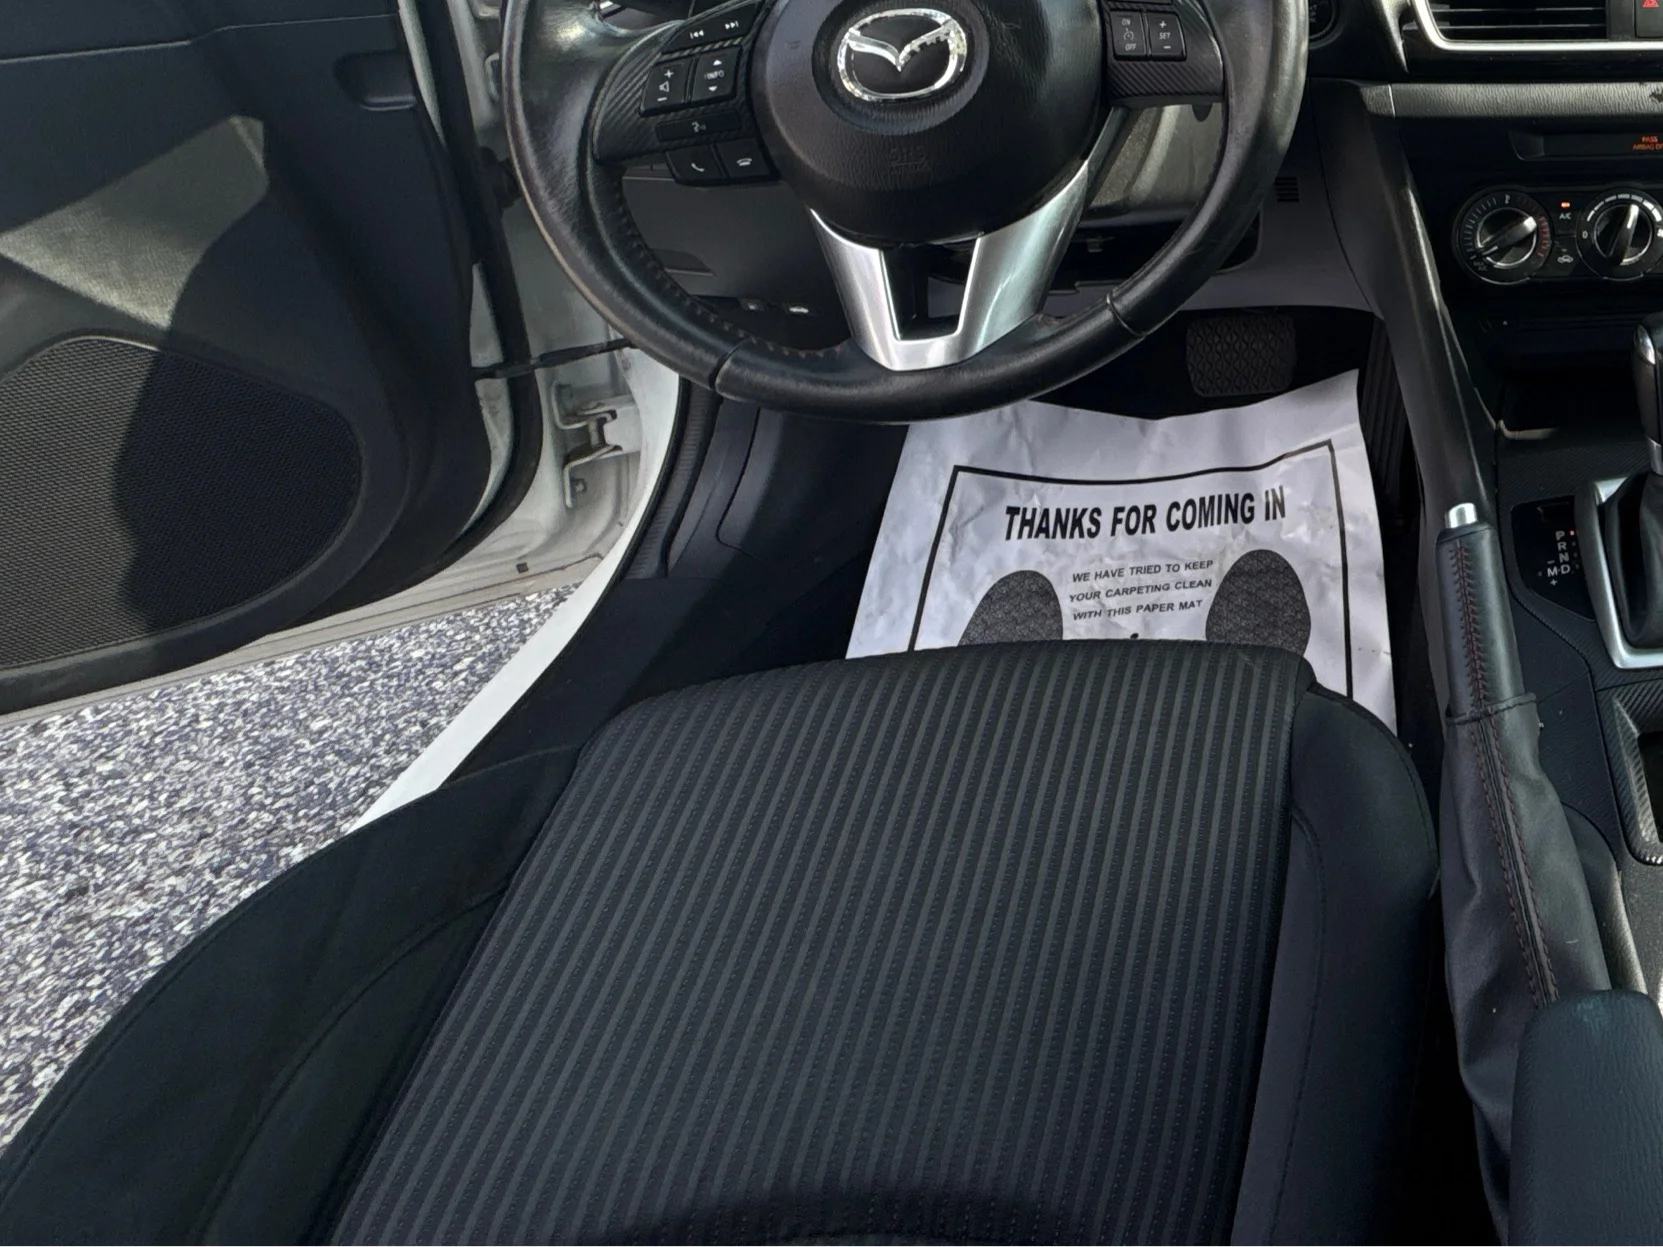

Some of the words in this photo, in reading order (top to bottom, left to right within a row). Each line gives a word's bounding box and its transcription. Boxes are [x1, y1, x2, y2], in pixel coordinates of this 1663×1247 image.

[1122, 18, 1131, 27] ON
[1159, 32, 1171, 40] SET
[1124, 43, 1137, 51] OFF
[706, 70, 725, 80] INFO
[1632, 143, 1654, 151] AIRBAG
[1559, 212, 1572, 221] A/C
[1582, 231, 1588, 239] 0
[1004, 506, 1102, 541] THANKS
[1110, 504, 1158, 537] FOR
[1166, 492, 1255, 532] COMING
[1264, 486, 1287, 522] IN
[1555, 530, 1566, 541] P
[1558, 542, 1567, 551] R
[1558, 552, 1570, 563] N
[1072, 572, 1091, 583] WE
[1094, 568, 1125, 581] HAVE
[1128, 564, 1162, 576] TRIED
[1166, 563, 1181, 573] TO
[1184, 560, 1214, 571] KEEP
[1547, 566, 1558, 578] M
[1560, 564, 1571, 575] D
[1069, 590, 1101, 603] YOUR
[1104, 583, 1171, 598] CARPETING
[1174, 578, 1213, 590] CLEAN
[1072, 610, 1103, 621] WITH
[1106, 606, 1132, 618] THIS
[1136, 602, 1175, 614] PAPER
[1178, 600, 1204, 611] MAT
